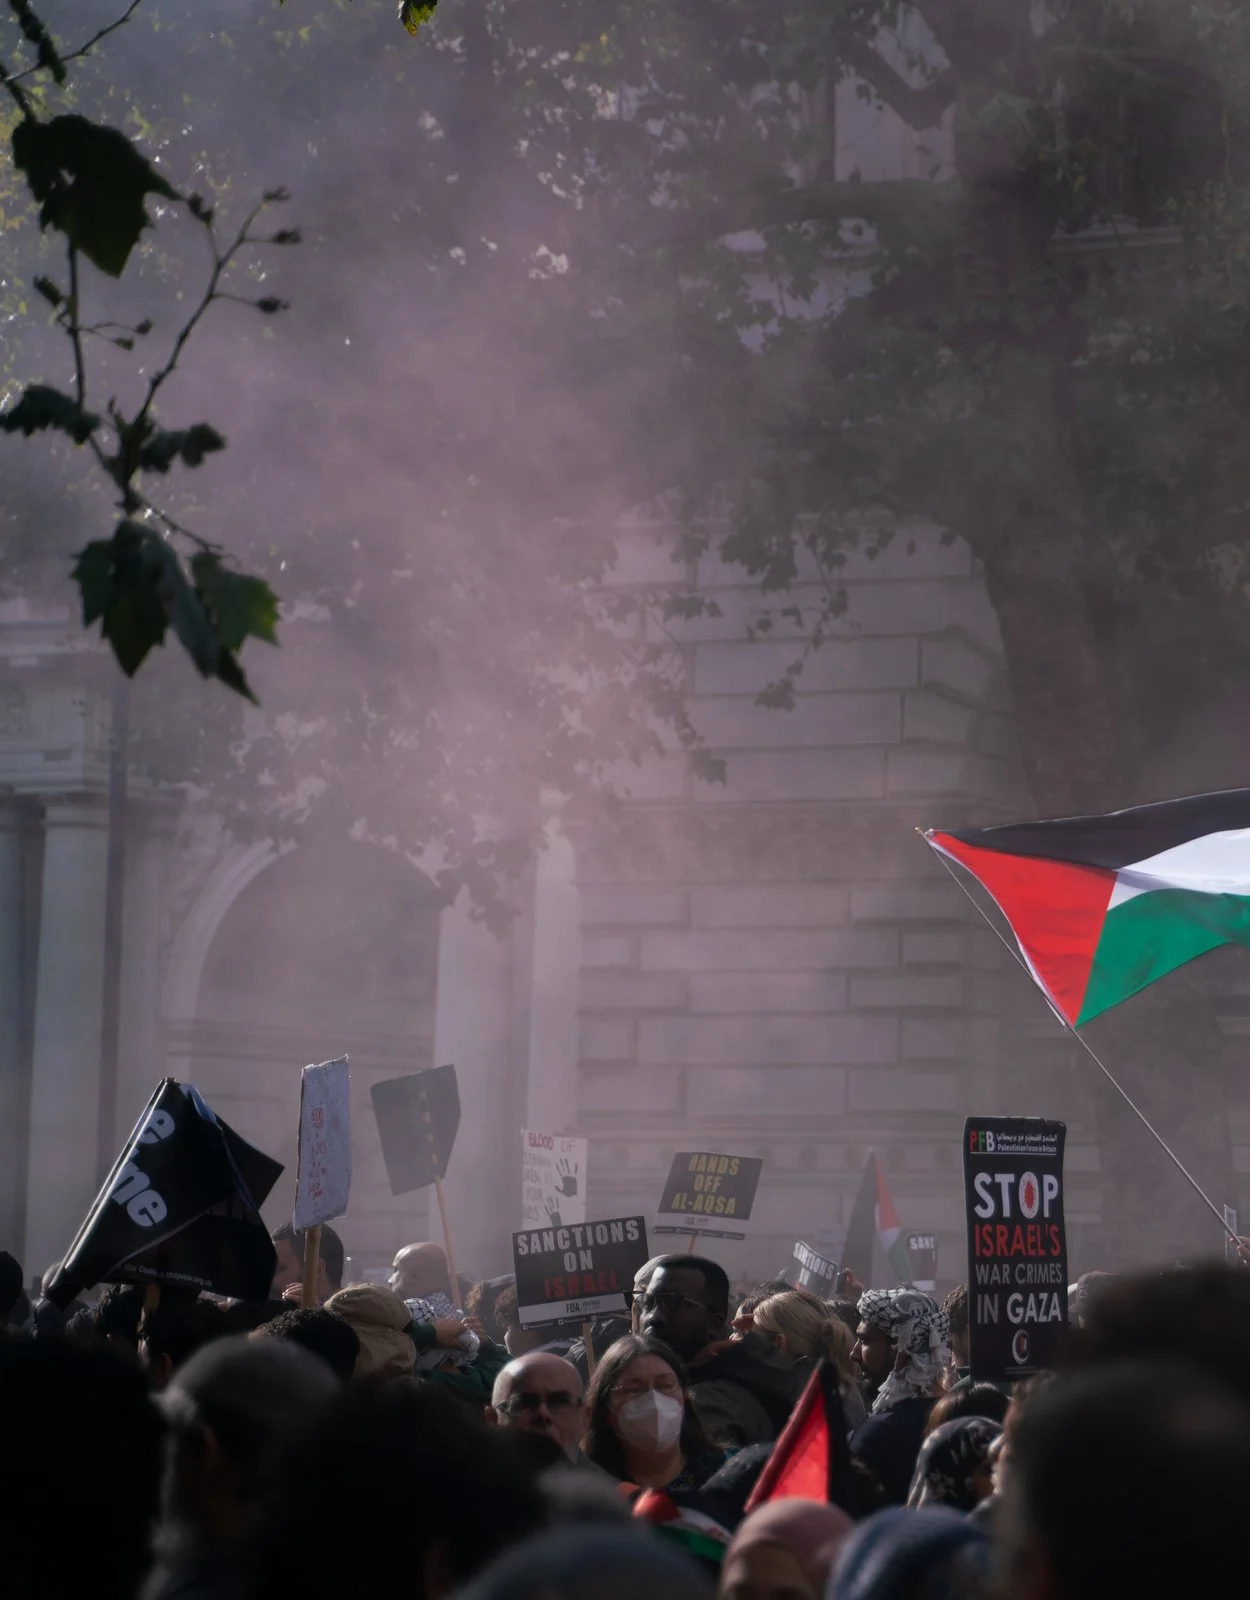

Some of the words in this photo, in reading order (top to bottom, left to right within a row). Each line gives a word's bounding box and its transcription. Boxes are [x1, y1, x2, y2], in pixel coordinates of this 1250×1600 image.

[528, 1131, 554, 1150] BLOOD
[561, 1139, 577, 1153] OF
[970, 1129, 995, 1152] PFB
[997, 1143, 1026, 1152] Palestinian
[688, 1154, 740, 1176] HANDS
[694, 1174, 723, 1193] OFF
[974, 1171, 1059, 1219] STOP
[671, 1192, 736, 1215] AL-AQSA
[517, 1219, 640, 1255] SANCTIONS
[974, 1223, 1061, 1257] ISRAEL'S
[563, 1249, 594, 1273] ON
[543, 1269, 621, 1300] ISRAEL
[975, 1263, 1011, 1285] WAR
[1014, 1262, 1062, 1284] CRIMES
[566, 1302, 580, 1313] FOA
[977, 1293, 999, 1325] IN
[1006, 1292, 1062, 1325] GAZA
